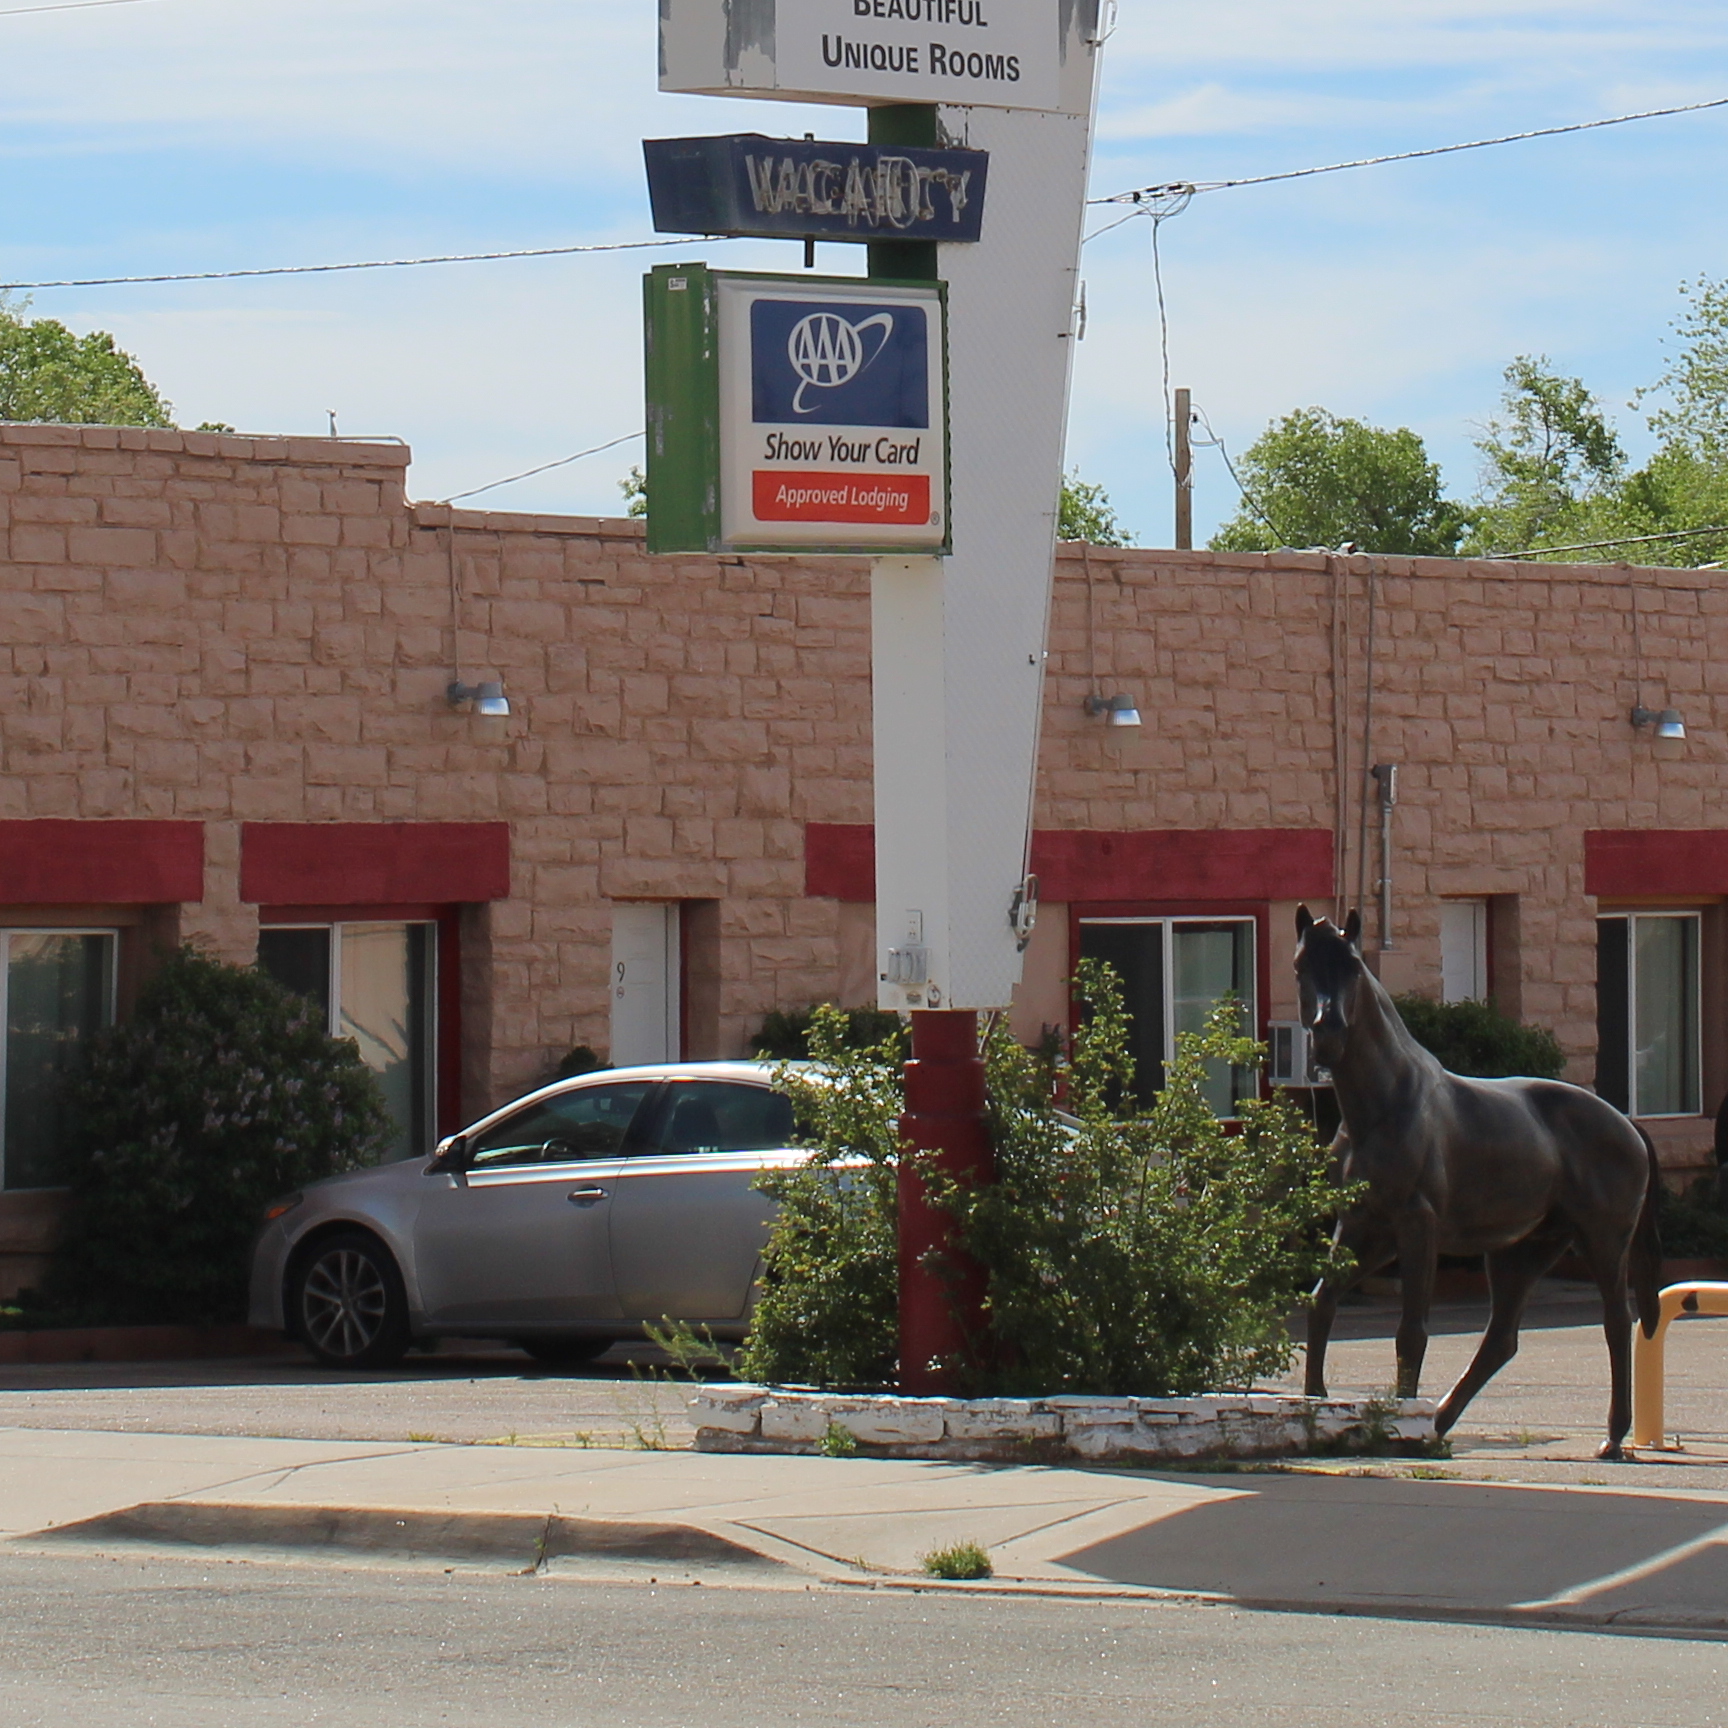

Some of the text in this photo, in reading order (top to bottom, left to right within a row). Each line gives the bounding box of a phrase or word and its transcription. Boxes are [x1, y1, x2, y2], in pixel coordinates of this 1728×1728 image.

[821, 33, 1021, 83] UNIQUE ROOMS
[791, 313, 859, 387] AAA
[764, 432, 921, 465] Show Your Card
[775, 484, 909, 513] Approved Lodging
[616, 961, 626, 983] 9
